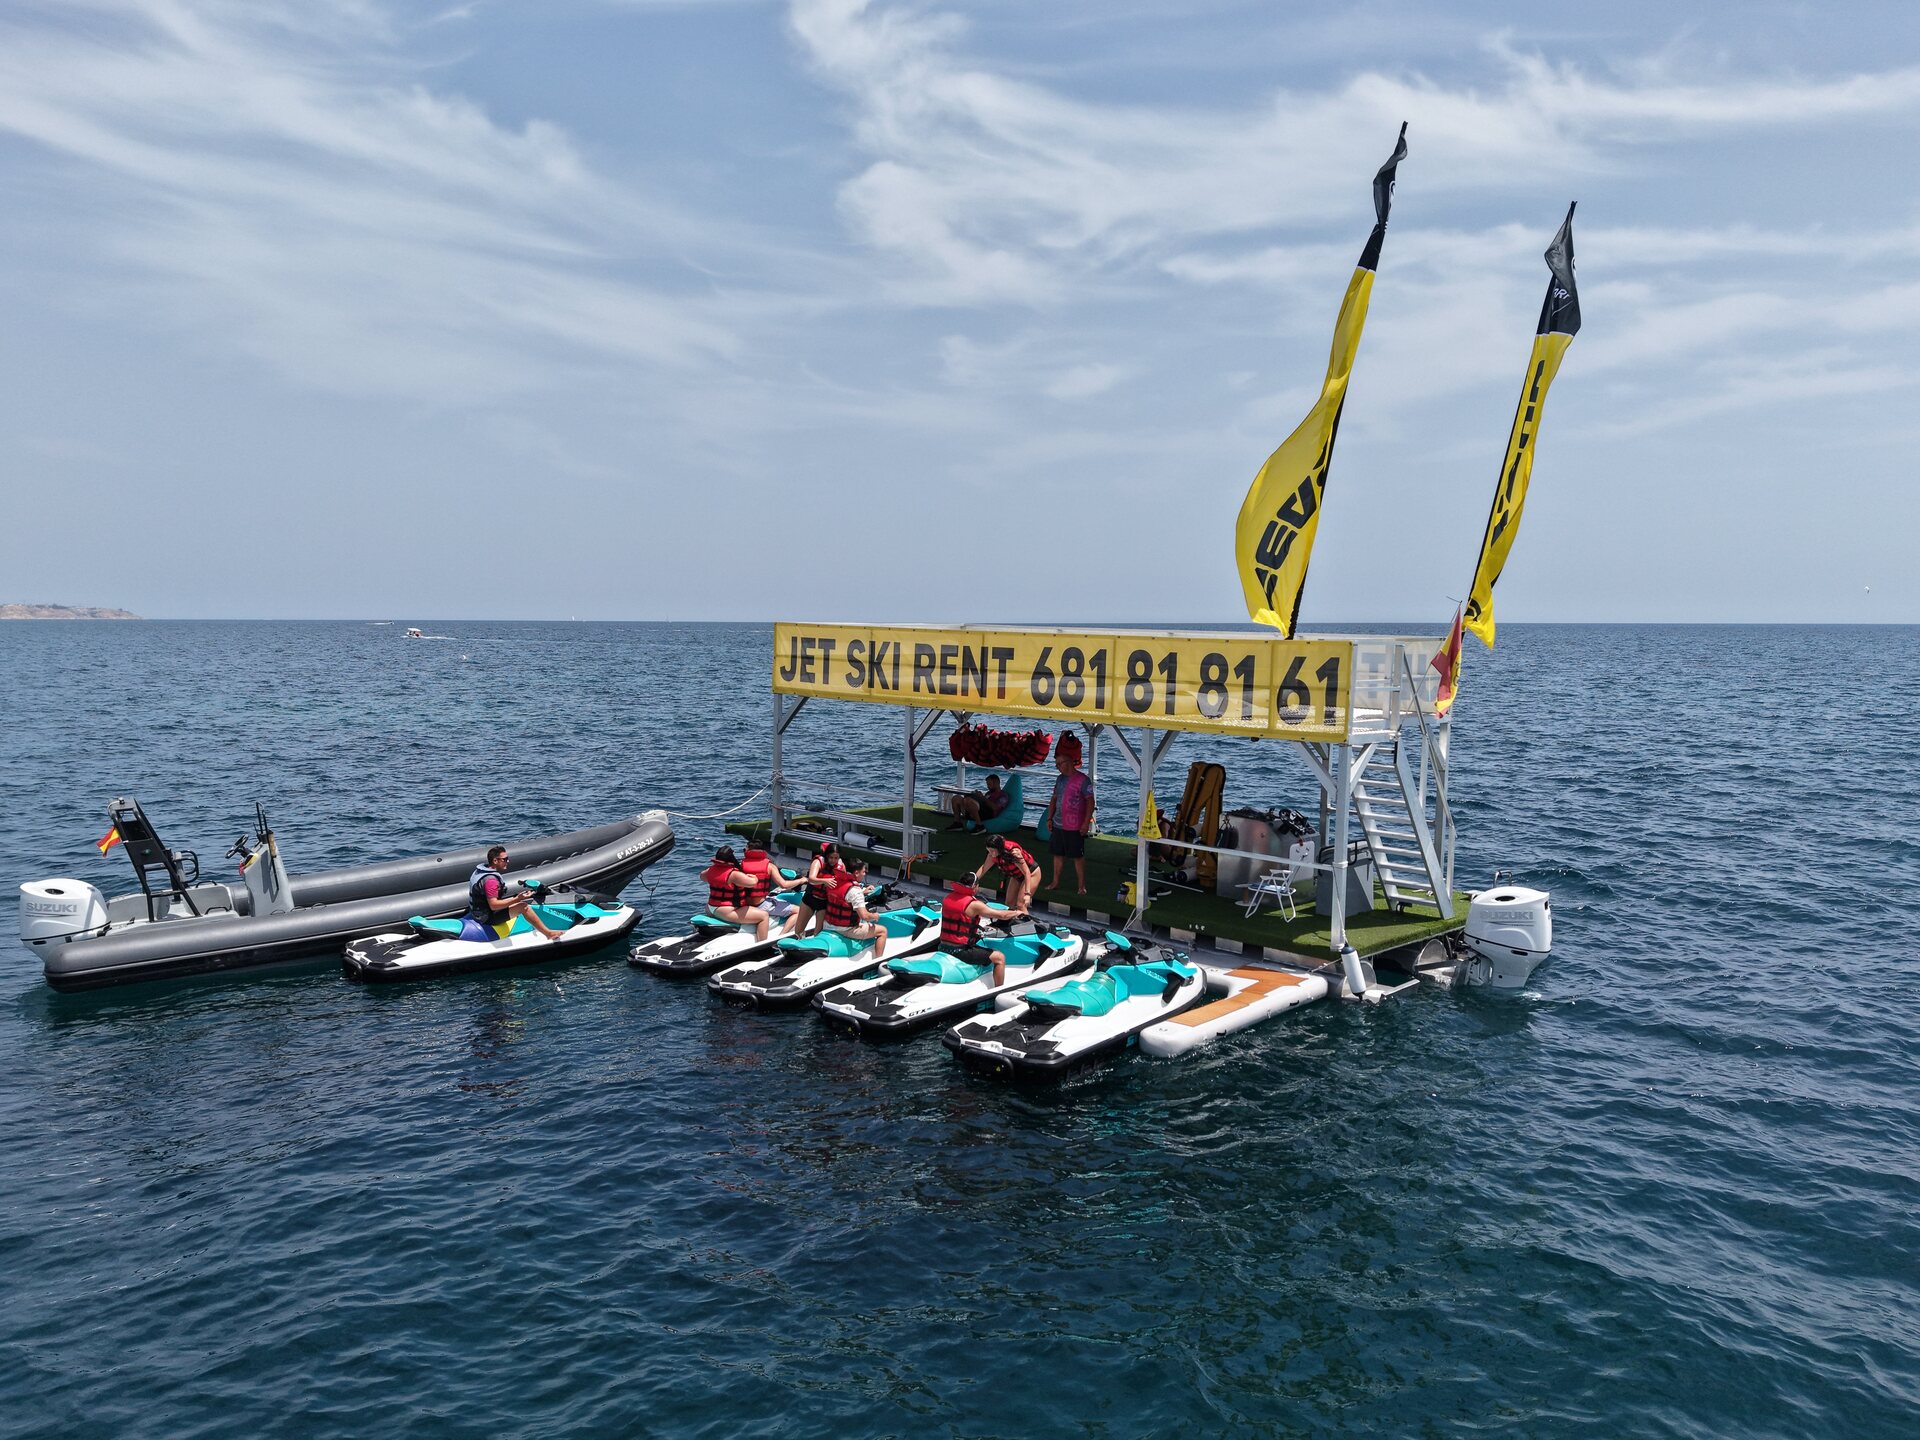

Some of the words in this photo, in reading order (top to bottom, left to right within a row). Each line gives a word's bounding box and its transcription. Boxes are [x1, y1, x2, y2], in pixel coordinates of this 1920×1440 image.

[780, 636, 836, 684] JET
[845, 639, 900, 692] SKI
[912, 643, 1014, 700] RENT
[1030, 647, 1107, 709] 681
[1124, 649, 1178, 715] 81
[1197, 652, 1256, 720] 81
[1276, 656, 1340, 727] 61
[26, 903, 77, 912] SUZUKI
[1480, 911, 1534, 920] SUZUKI
